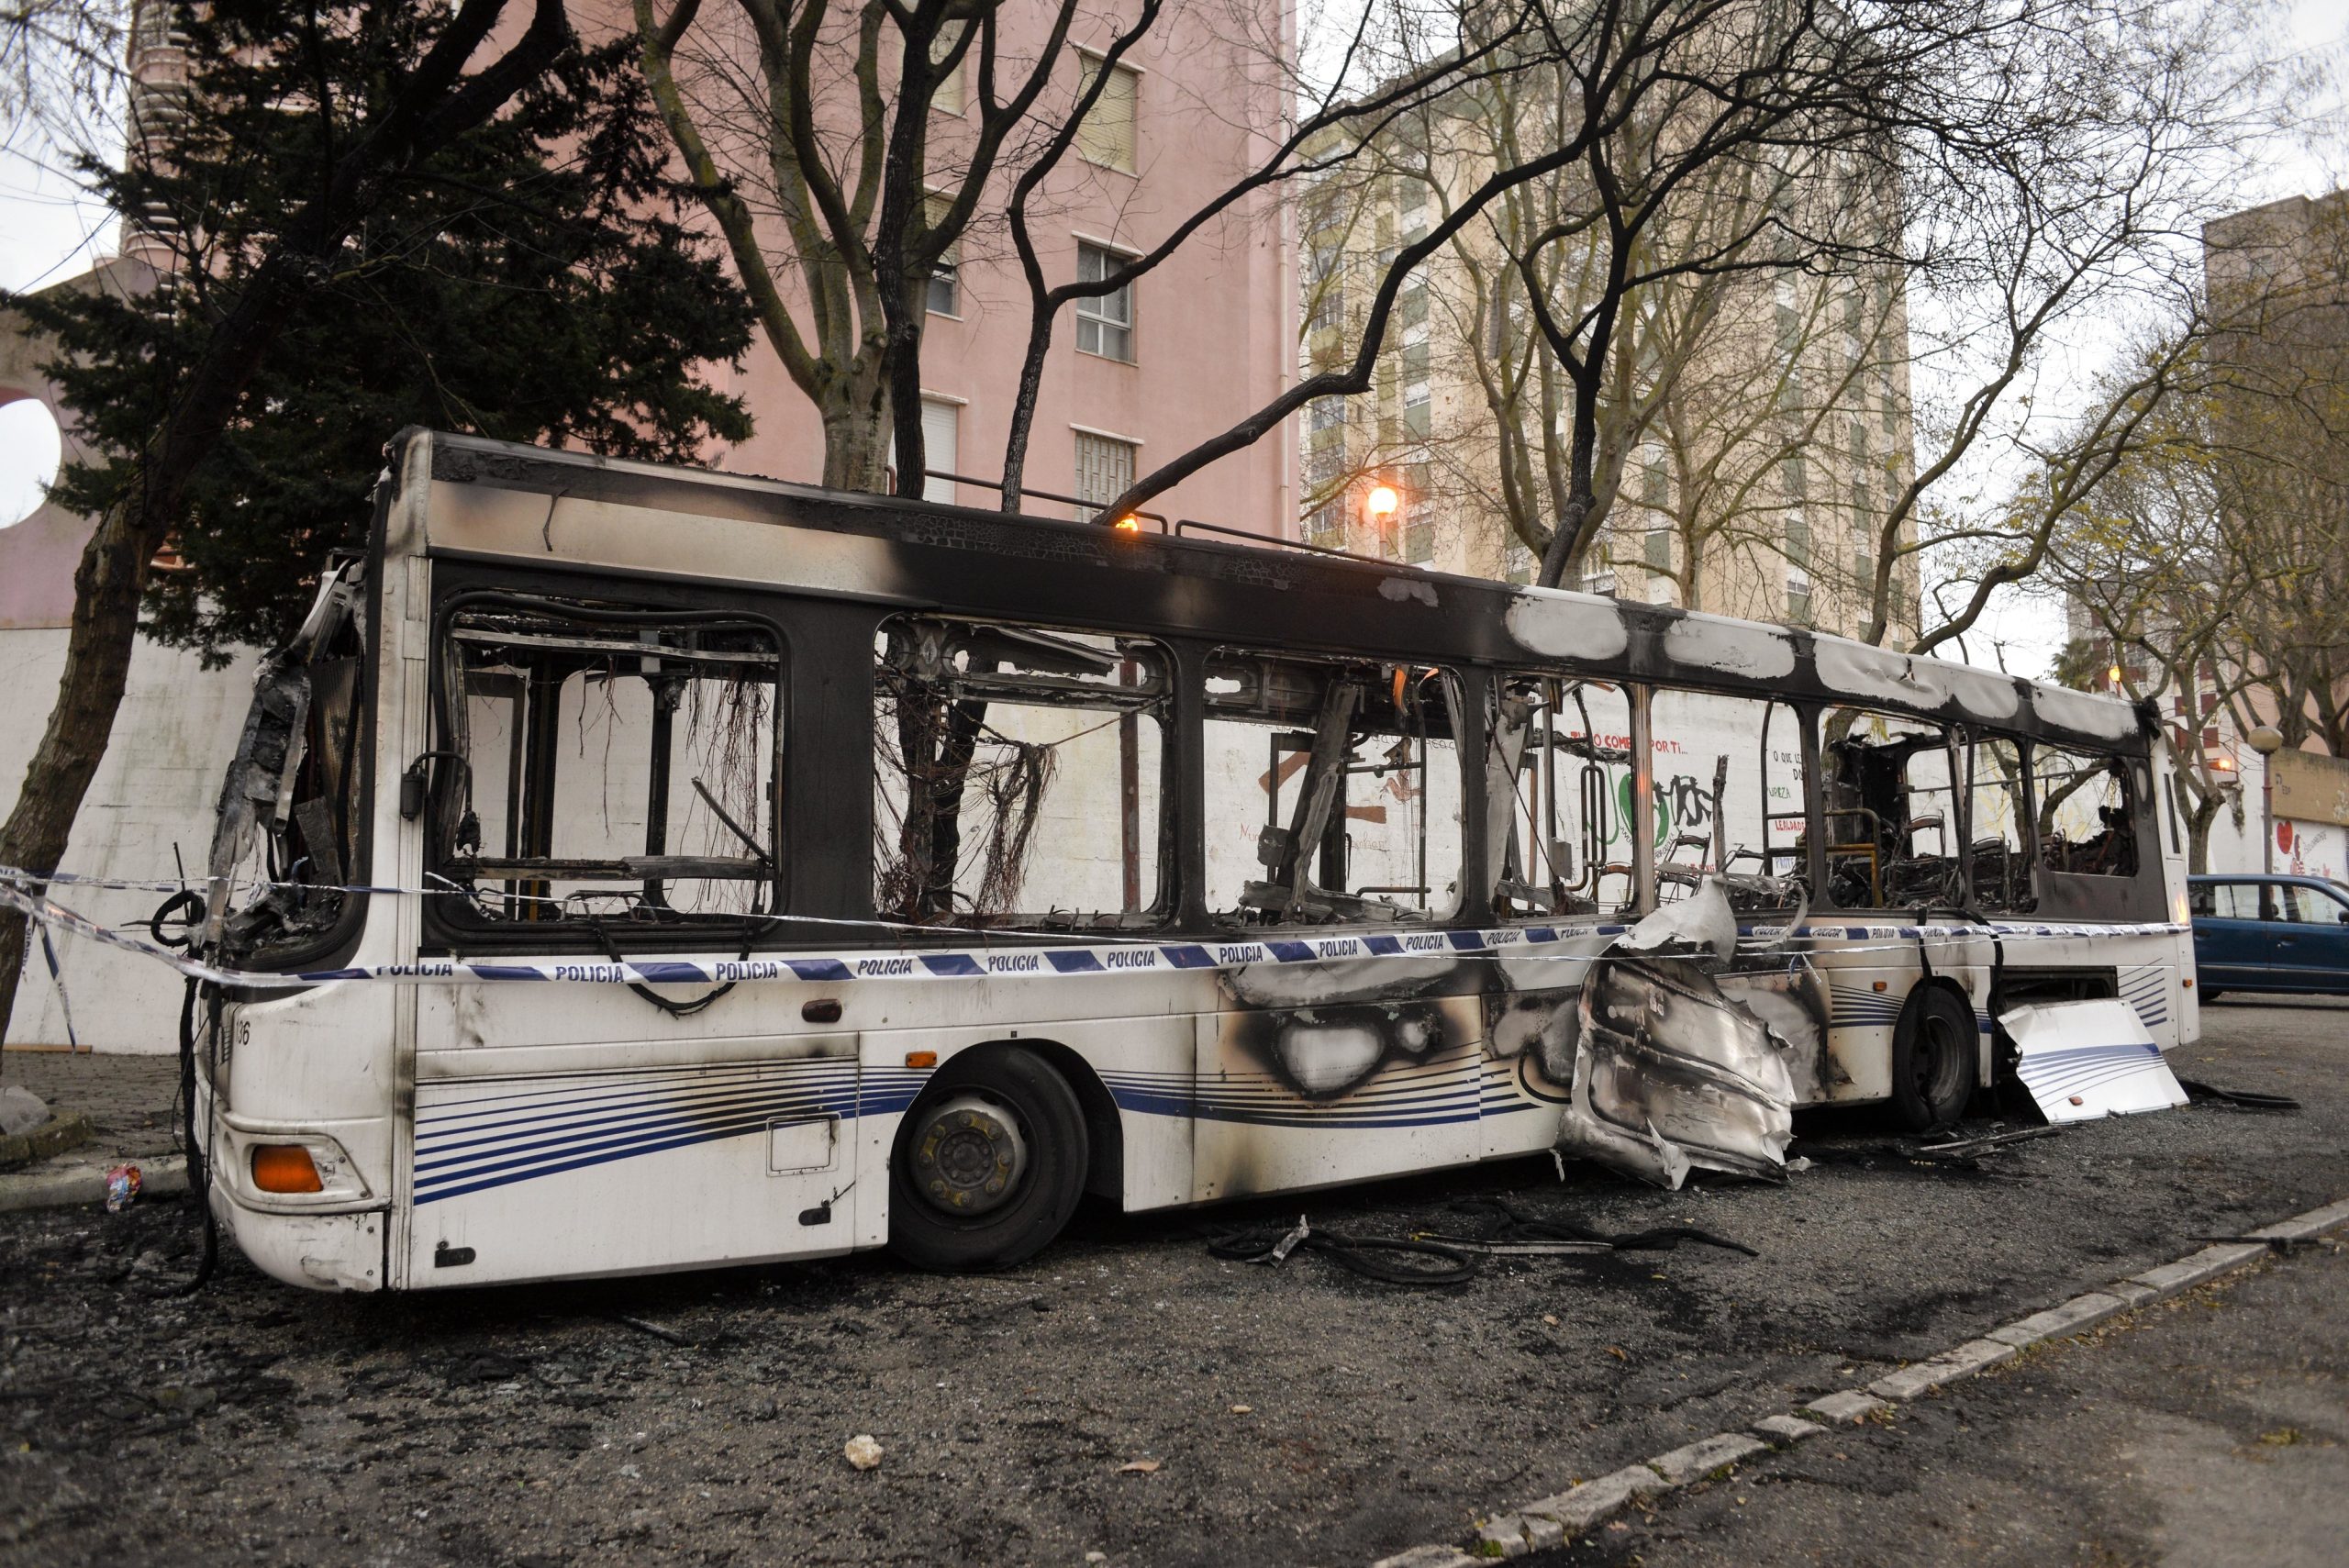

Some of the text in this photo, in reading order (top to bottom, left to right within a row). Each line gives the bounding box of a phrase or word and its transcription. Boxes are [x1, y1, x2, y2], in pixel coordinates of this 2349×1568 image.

[555, 965, 624, 983] POLICIA
[716, 962, 777, 981] POLICIA
[857, 959, 913, 976] POLICIA
[988, 955, 1039, 973] POLICIA
[1107, 951, 1155, 968] POLICIA
[1219, 945, 1264, 963] POLICIA
[1319, 940, 1358, 957] POLICIA
[1406, 935, 1443, 951] POLICIA
[1486, 930, 1521, 945] POLICIA
